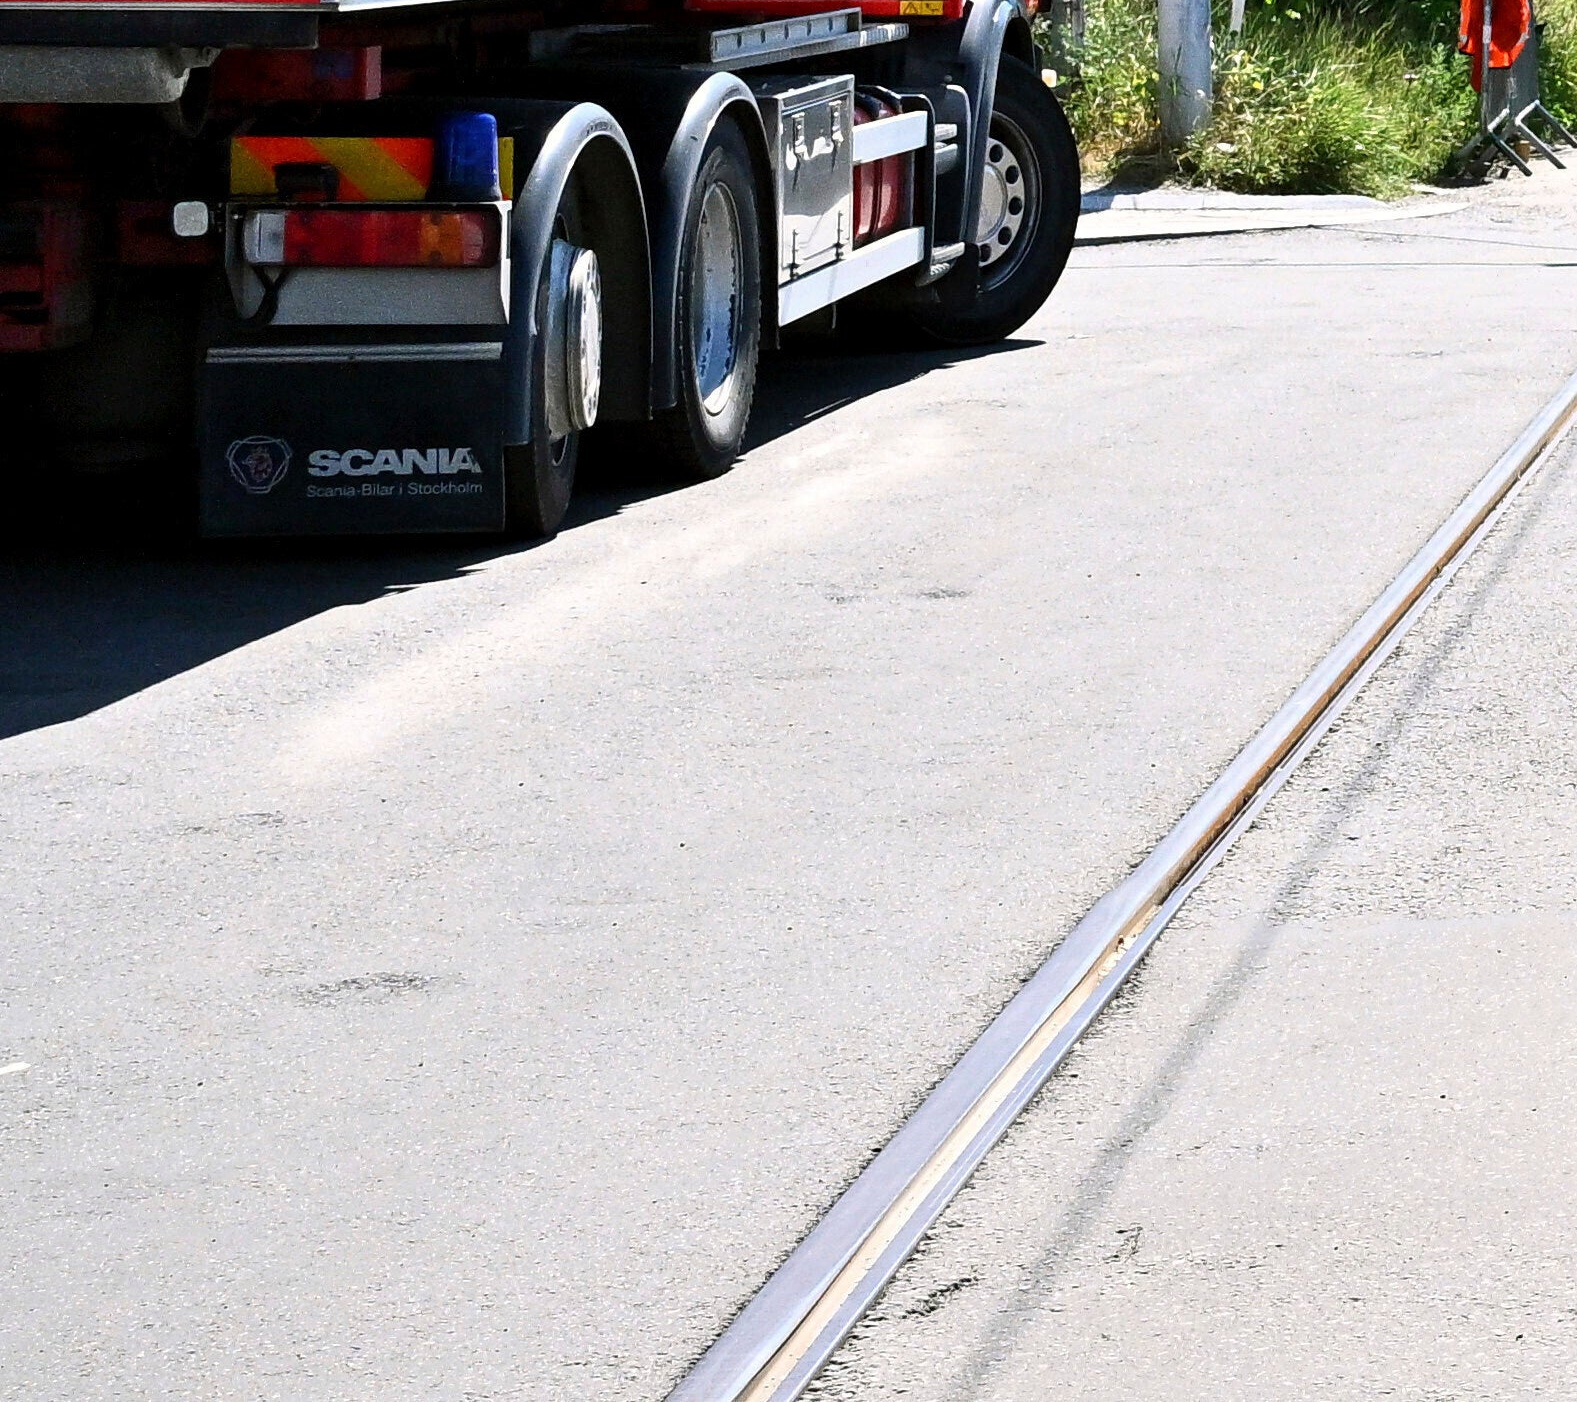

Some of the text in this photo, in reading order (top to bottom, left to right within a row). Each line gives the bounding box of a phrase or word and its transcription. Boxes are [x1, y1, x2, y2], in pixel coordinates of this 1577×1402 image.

[307, 448, 483, 476] SCANIA
[306, 482, 395, 498] Scania-Bilar
[408, 481, 483, 495] Stockholm
